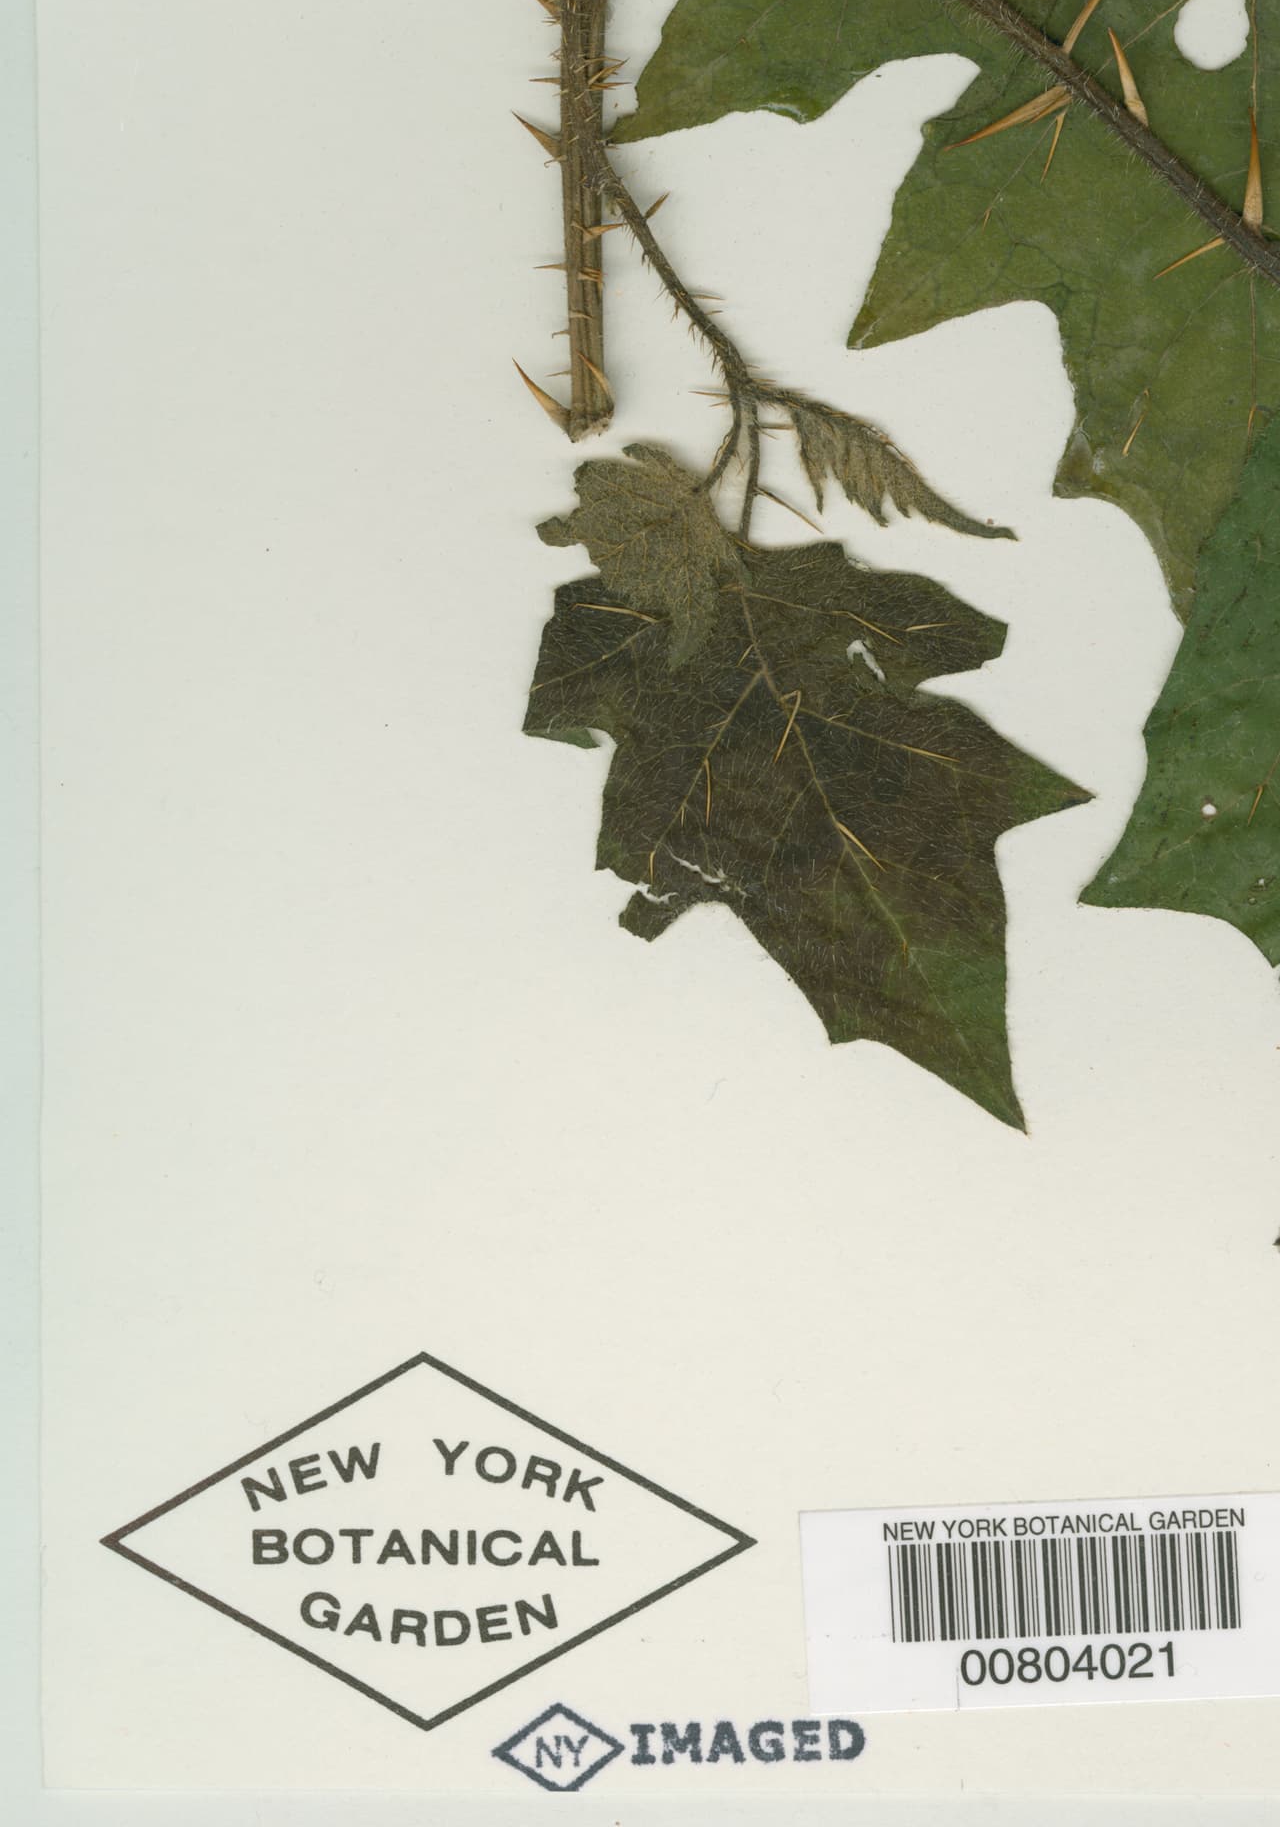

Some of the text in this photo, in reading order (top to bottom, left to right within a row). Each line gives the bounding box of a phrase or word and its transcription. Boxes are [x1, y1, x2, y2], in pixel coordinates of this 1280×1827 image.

[240, 1438, 604, 1512] NEW YORK
[253, 1529, 599, 1566] BOTANICAL
[882, 1509, 1246, 1541] NEW YORK BOTANICAL GARDEN
[299, 1592, 559, 1647] GARDEN
[961, 1642, 1174, 1685] 00804021
[534, 1719, 867, 1769] NY IMAGED
